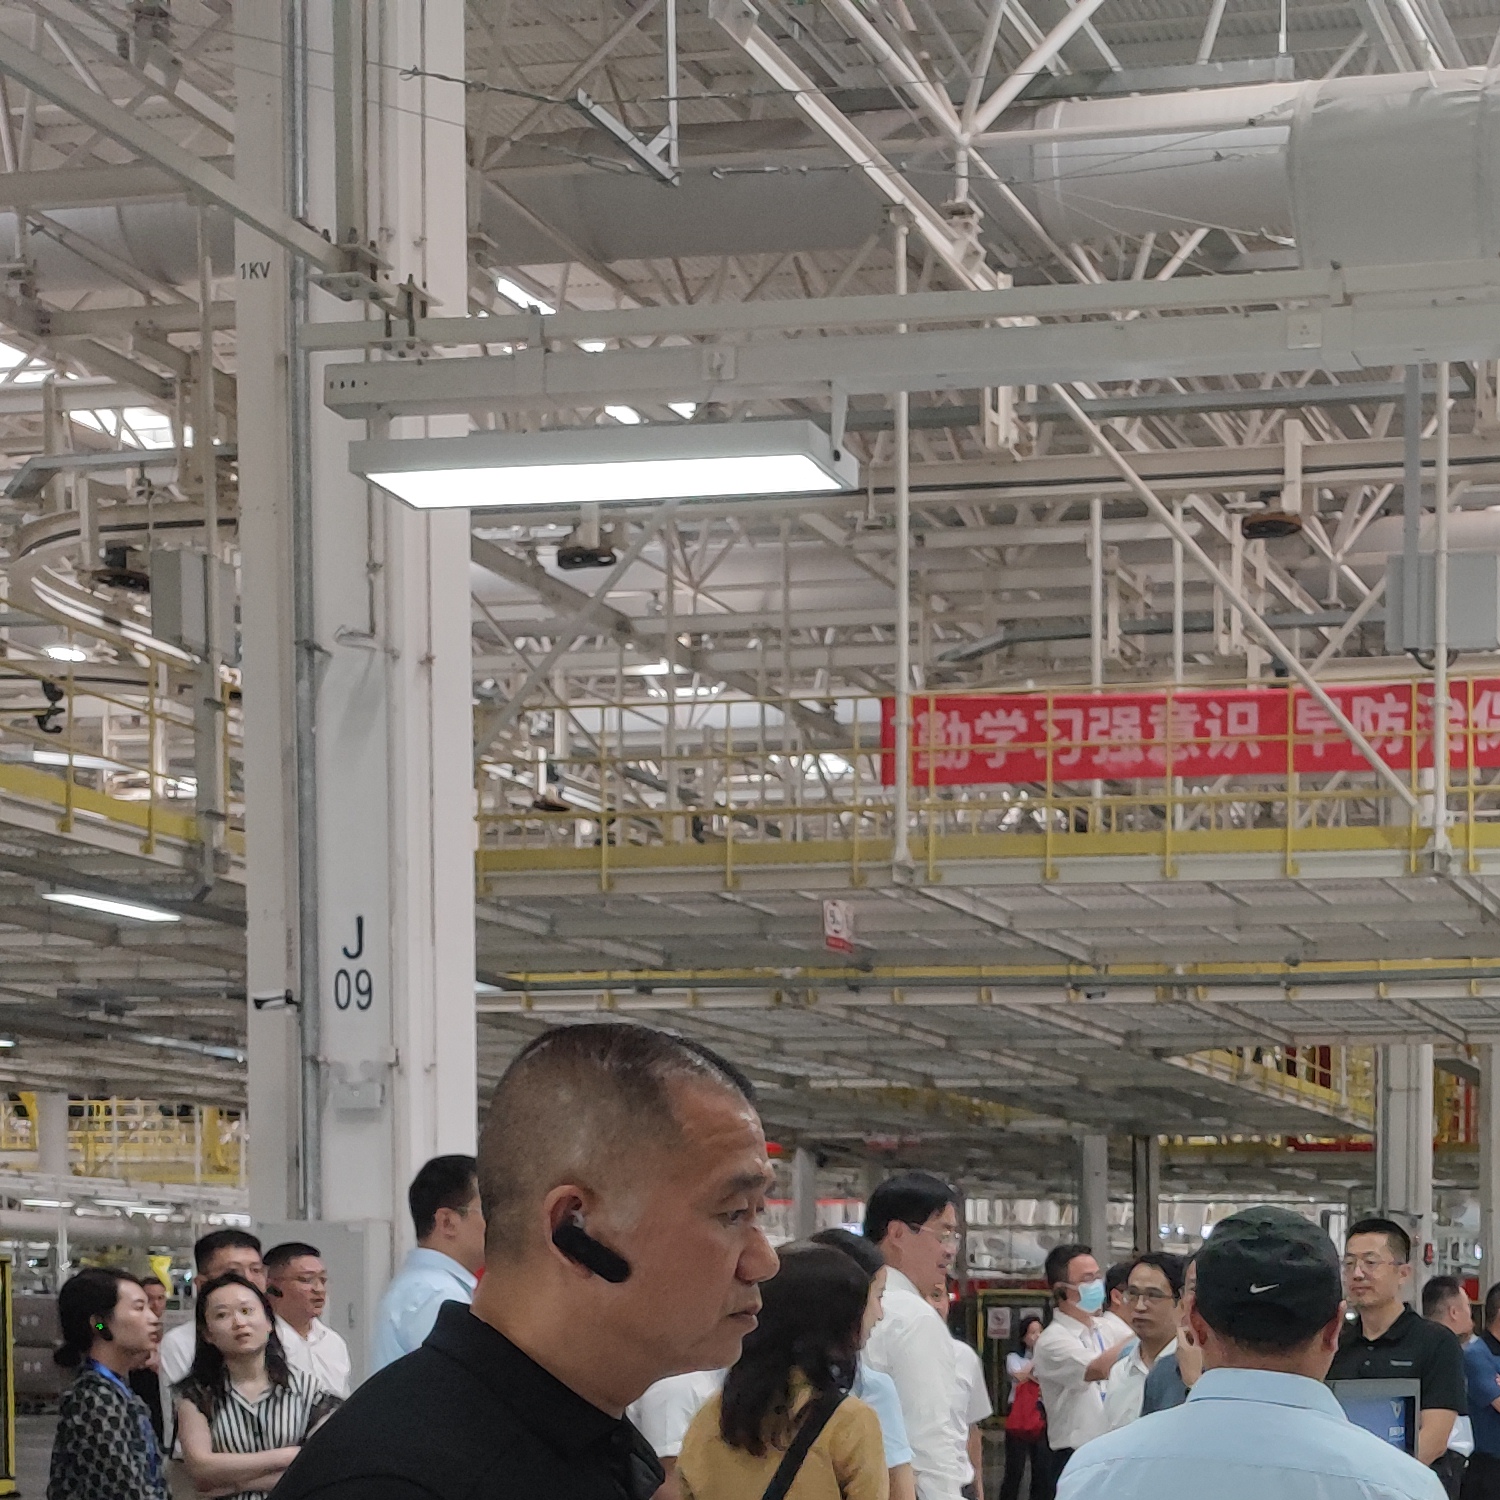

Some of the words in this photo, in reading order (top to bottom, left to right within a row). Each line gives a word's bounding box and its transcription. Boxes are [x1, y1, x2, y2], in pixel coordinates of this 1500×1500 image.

[239, 260, 272, 281] 1KV
[916, 701, 1262, 770] 勤学习强意识
[342, 914, 365, 960] J
[333, 968, 374, 1011] 09
